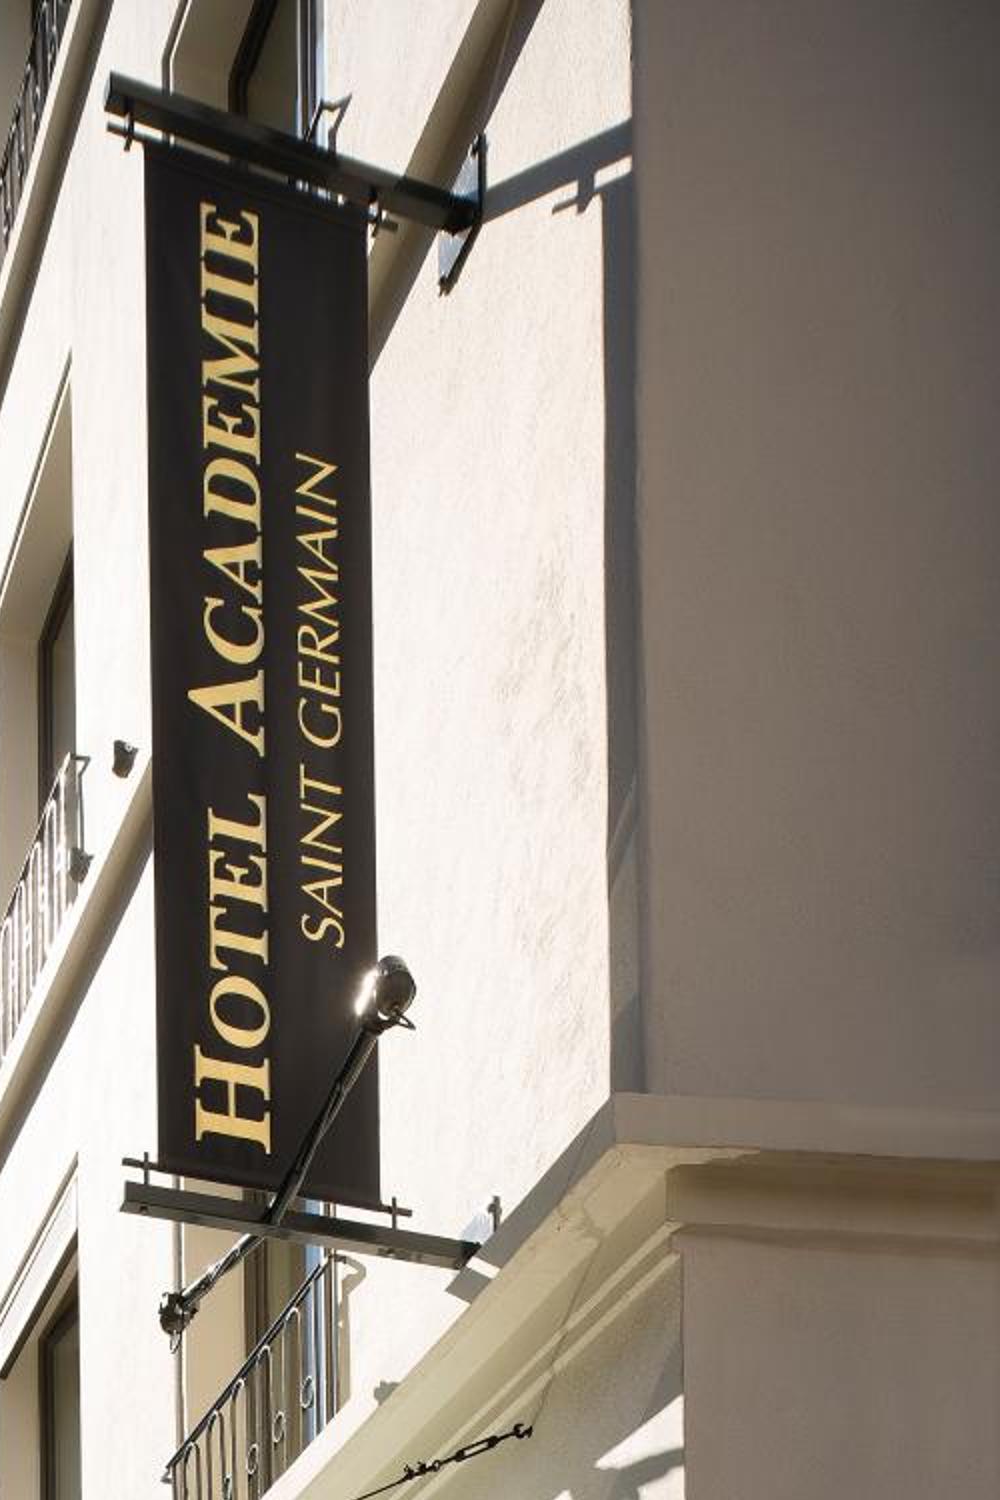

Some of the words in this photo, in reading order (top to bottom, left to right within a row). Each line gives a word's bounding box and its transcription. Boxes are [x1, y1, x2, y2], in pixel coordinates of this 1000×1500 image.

[187, 203, 265, 758] ACADEMIE
[294, 452, 342, 749] GERMAIN
[194, 792, 273, 1155] HOTEL
[298, 763, 346, 949] SAINT
